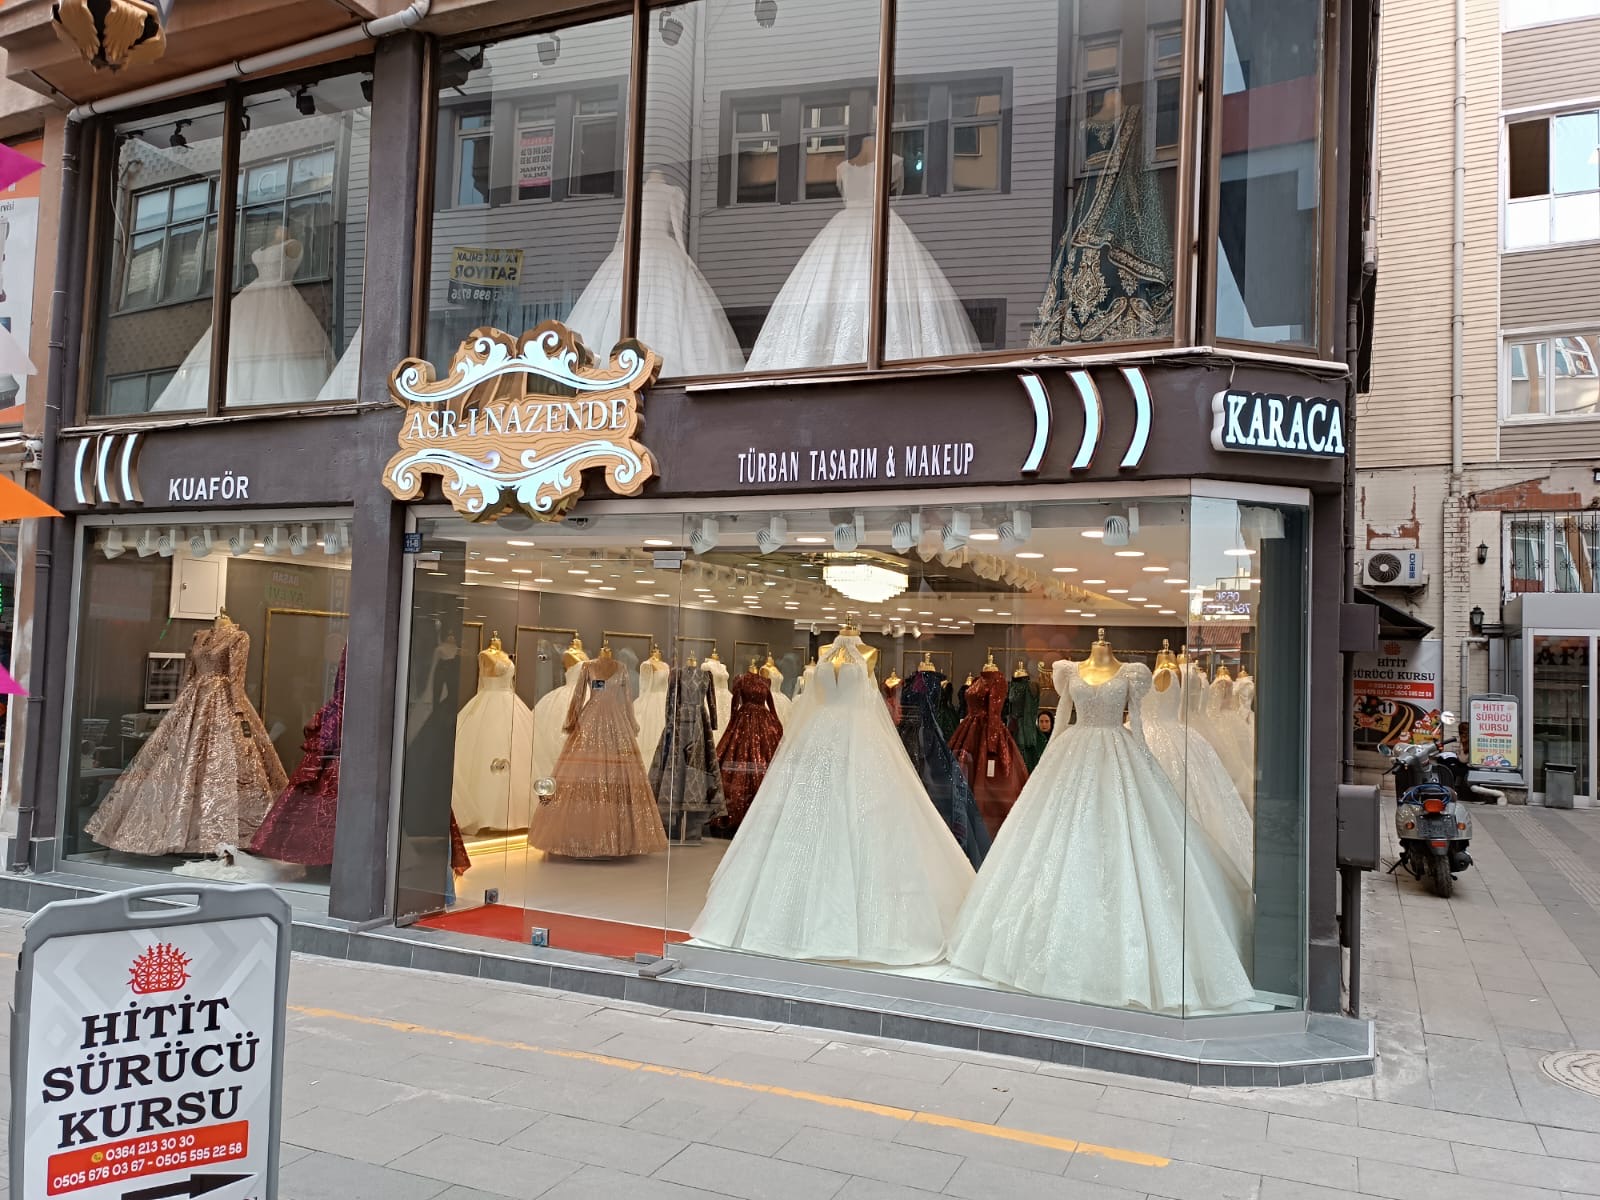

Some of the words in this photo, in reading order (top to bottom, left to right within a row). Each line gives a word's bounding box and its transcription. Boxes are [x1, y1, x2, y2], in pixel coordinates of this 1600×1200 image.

[485, 399, 628, 437] NAZENDE
[1225, 394, 1345, 454] KARACA
[738, 447, 799, 483] TÜRBAN
[809, 447, 878, 481] TASARIM
[886, 445, 896, 478] &
[905, 442, 975, 477] MAKEUP
[168, 470, 249, 501] KUAFÖR
[1408, 552, 1416, 579] BEKO
[1377, 657, 1408, 668] HİTİT
[1397, 671, 1436, 682] KURSU
[1479, 723, 1509, 732] KURSU
[80, 994, 230, 1050] HİTİT
[42, 1031, 260, 1104] SÜRÜCÜ
[57, 1085, 243, 1150] KURSU
[53, 1171, 86, 1189] 0505
[88, 1166, 110, 1182] 676
[112, 1162, 128, 1176] 03
[130, 1158, 145, 1172] 67
[155, 1151, 187, 1167] 0505
[189, 1147, 210, 1161] 595
[212, 1145, 226, 1158] 22
[228, 1142, 242, 1155] 58
[105, 1144, 136, 1161] 0364
[138, 1140, 158, 1155] 213
[160, 1137, 176, 1151] 30
[179, 1134, 195, 1147] 30
